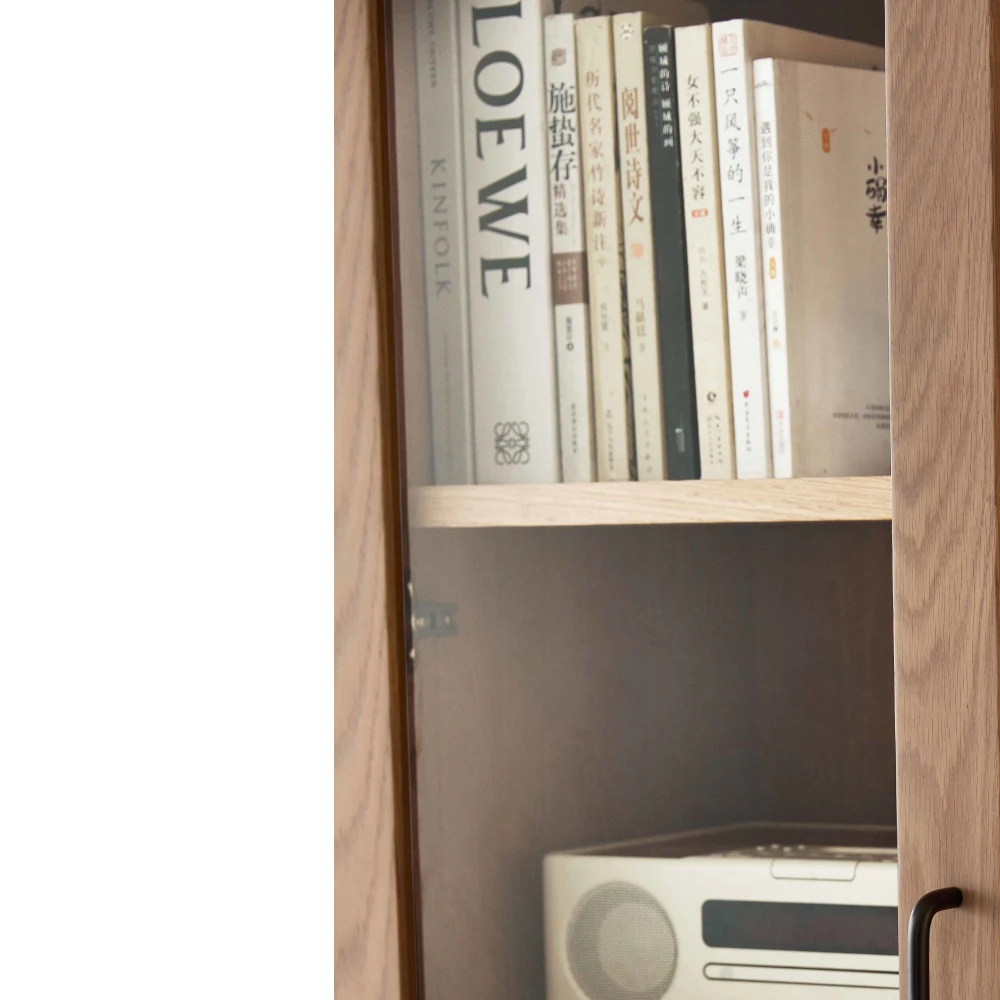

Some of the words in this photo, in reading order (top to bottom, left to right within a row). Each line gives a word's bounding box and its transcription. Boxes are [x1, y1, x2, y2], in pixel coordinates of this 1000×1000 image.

[471, 1, 532, 299] LOEWE
[549, 82, 577, 182] 施蛰存
[620, 86, 645, 226] 阅世诗文
[686, 73, 706, 202] 女不强大天不容
[720, 66, 747, 236] 一只风筝的一生
[760, 121, 775, 249] 遇到你是我的小确幸
[430, 158, 452, 299] KINFOLK
[553, 183, 569, 236] 精选集
[734, 254, 748, 299] 梁晓声
